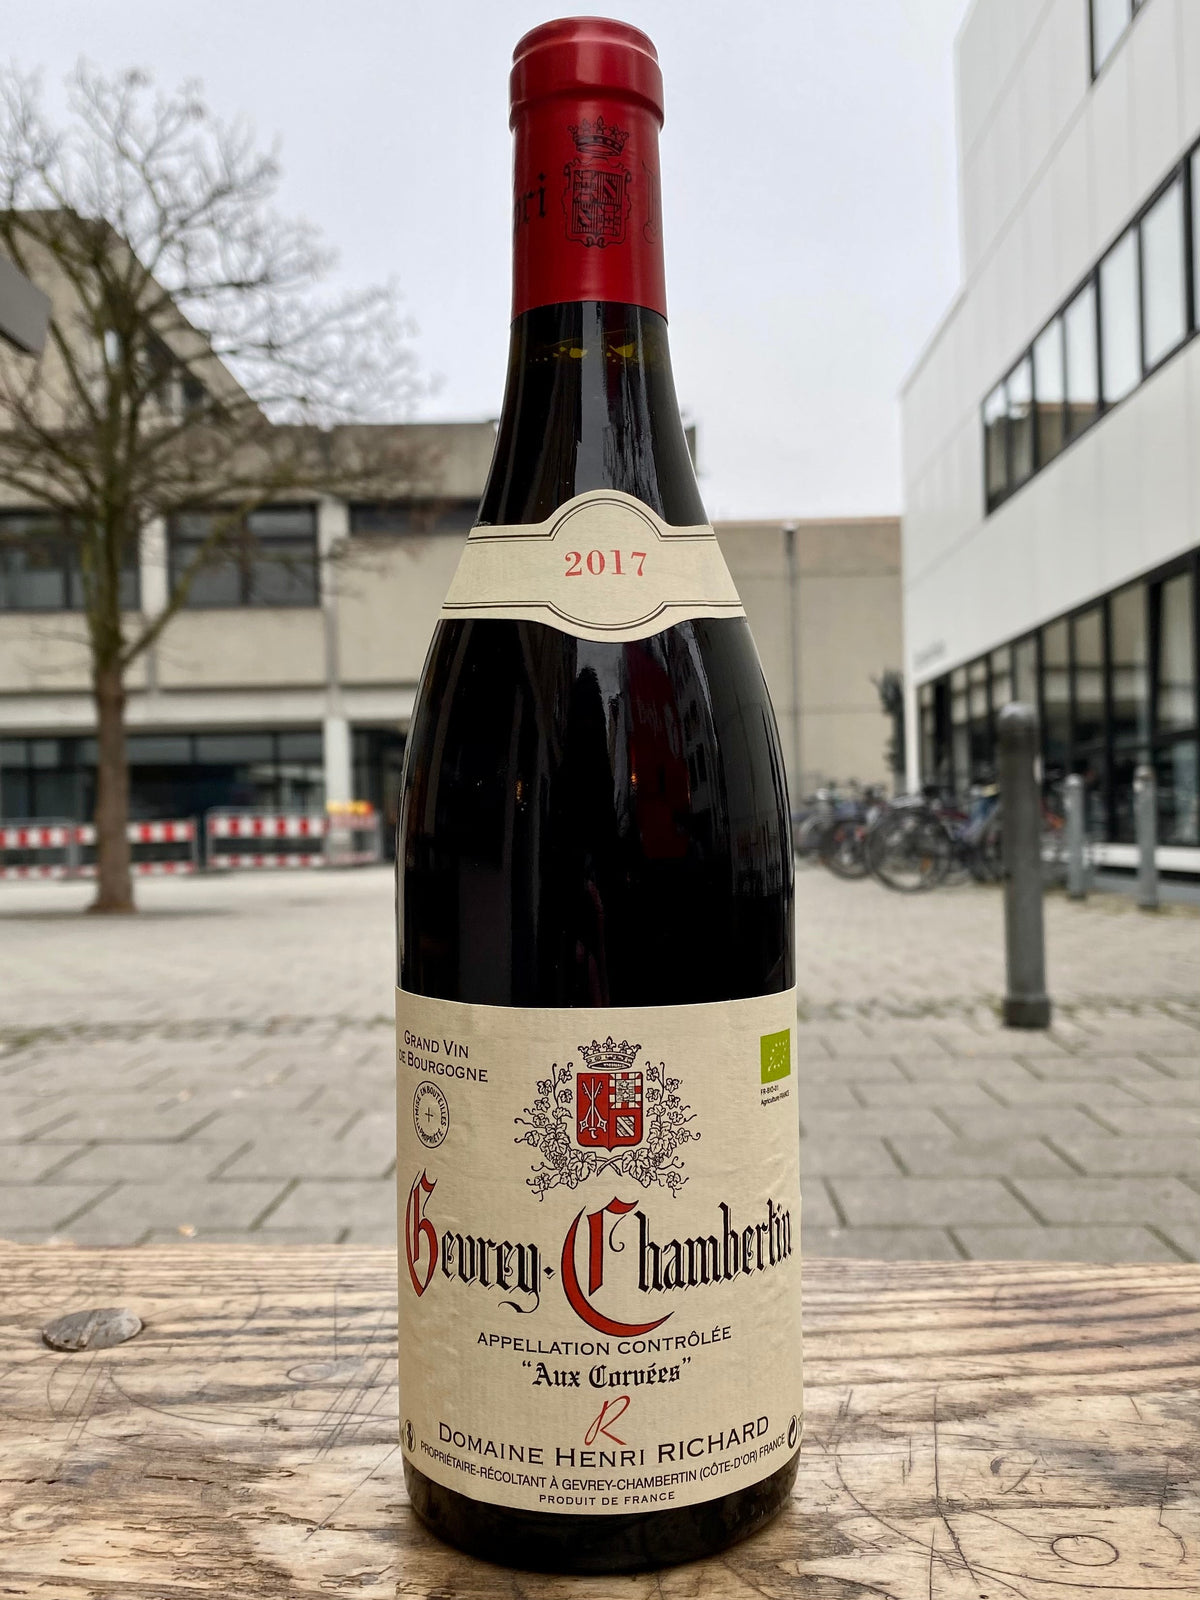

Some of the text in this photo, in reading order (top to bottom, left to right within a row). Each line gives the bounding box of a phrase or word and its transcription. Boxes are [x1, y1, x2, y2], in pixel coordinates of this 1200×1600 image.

[565, 550, 647, 577] 2017
[404, 1030, 469, 1059] GRAND VIN
[407, 1050, 488, 1083] BOURGOGNE
[426, 1085, 447, 1127] BOUTEILLES
[477, 1325, 732, 1356] APPELLATION CONTRÔLÉE
[584, 1395, 631, 1446] R
[439, 1415, 769, 1468] DOMAINE HENRI RICHARD
[420, 1432, 786, 1491] PROPRIÉTAIRE-RÉCOLTANT À GEVREY-CHAMBERTIN (CÔTE-D'OR) FRANCE
[539, 1491, 675, 1506] PRODUIT DE FRANCE
